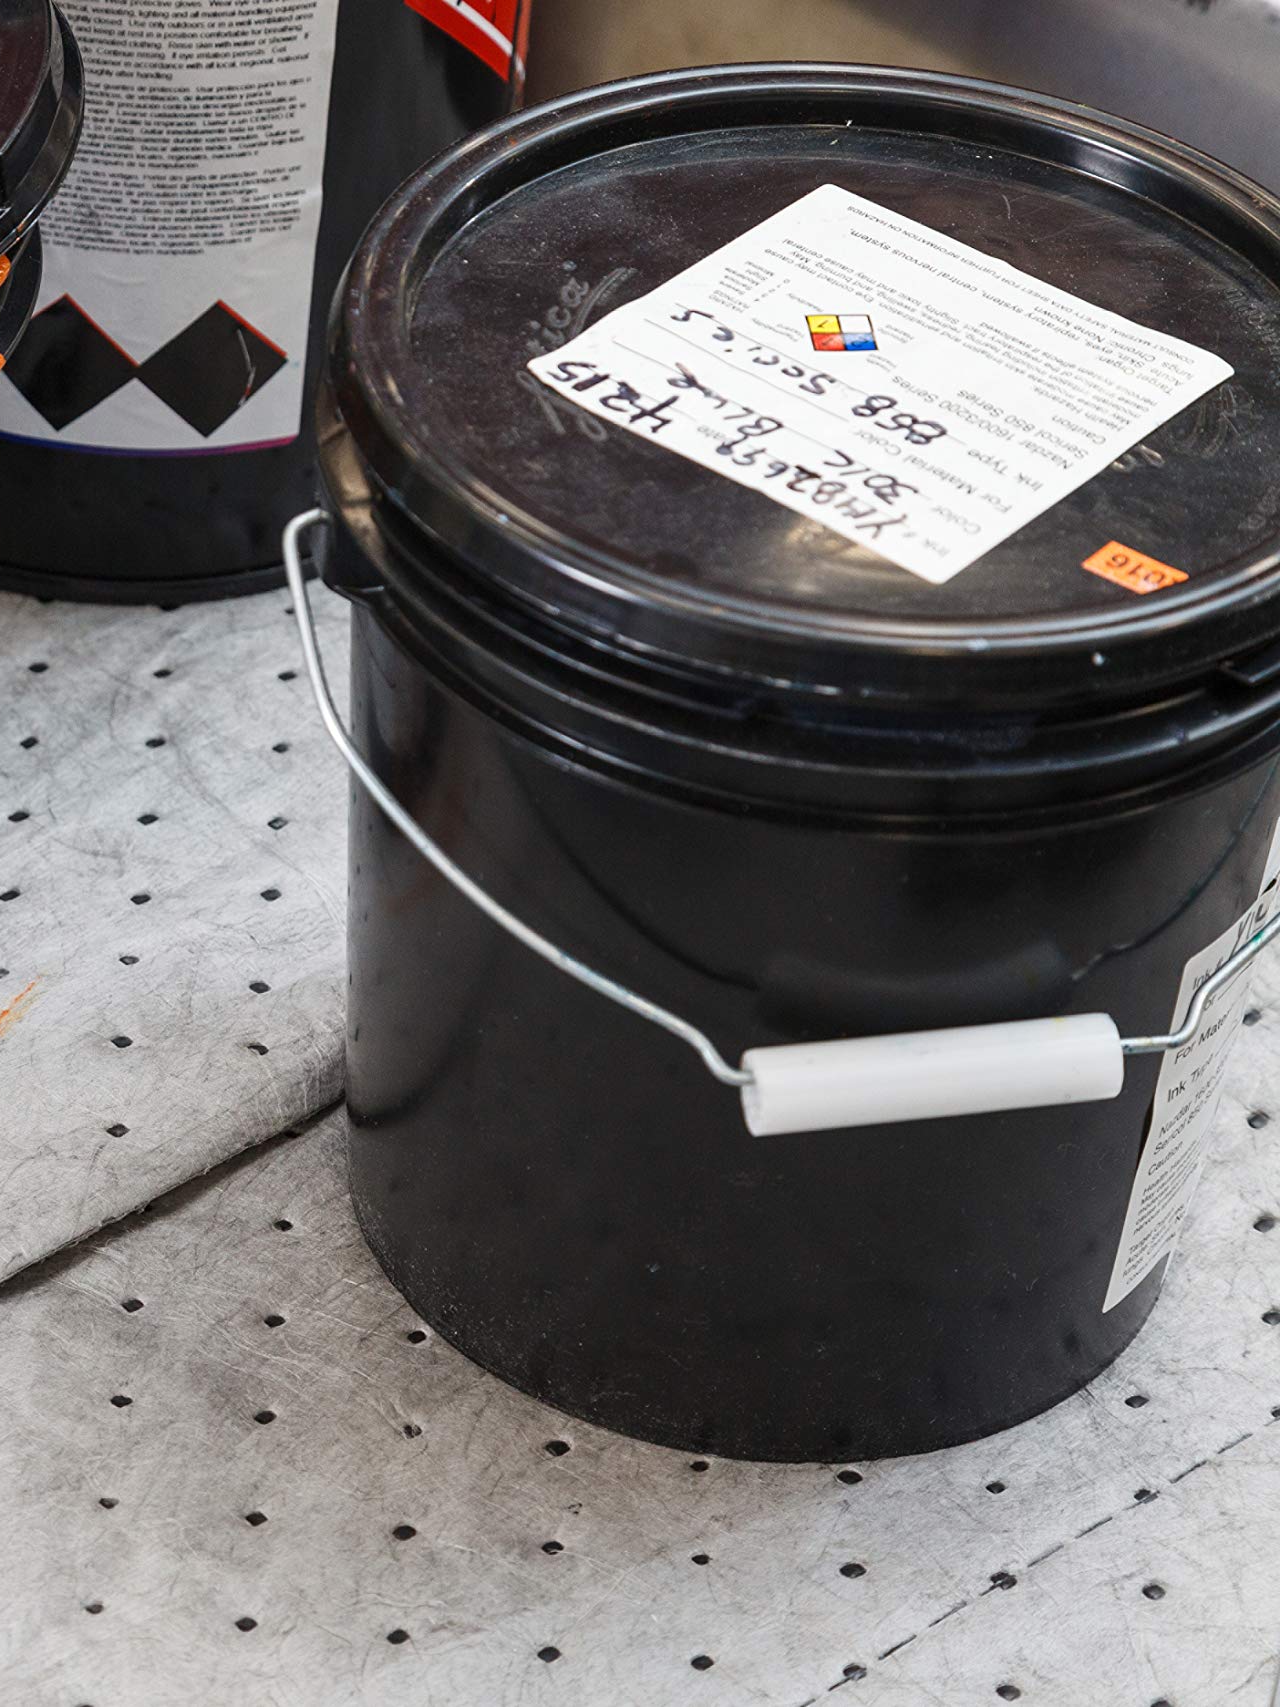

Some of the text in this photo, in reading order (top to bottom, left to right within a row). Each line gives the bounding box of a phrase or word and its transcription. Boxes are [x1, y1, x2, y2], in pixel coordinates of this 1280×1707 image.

[764, 248, 794, 263] cause
[792, 251, 809, 263] May
[823, 257, 854, 272] cause
[891, 249, 937, 272] nervous
[795, 262, 816, 274] may
[816, 272, 854, 292] contact
[936, 271, 977, 291] central
[854, 291, 874, 303] Eye
[1033, 306, 1104, 343] None known
[892, 375, 938, 402] Series
[852, 395, 946, 444] 858
[957, 390, 1088, 458] Sericol 850 Series
[1051, 415, 1106, 444] Caution
[1019, 441, 1072, 469] Nazdar
[854, 430, 1012, 513] For Material Color
[967, 450, 1042, 491] Ink Type
[1174, 1041, 1196, 1064] For
[1167, 1080, 1186, 1102] Ink
[1147, 1141, 1184, 1176] Caution
